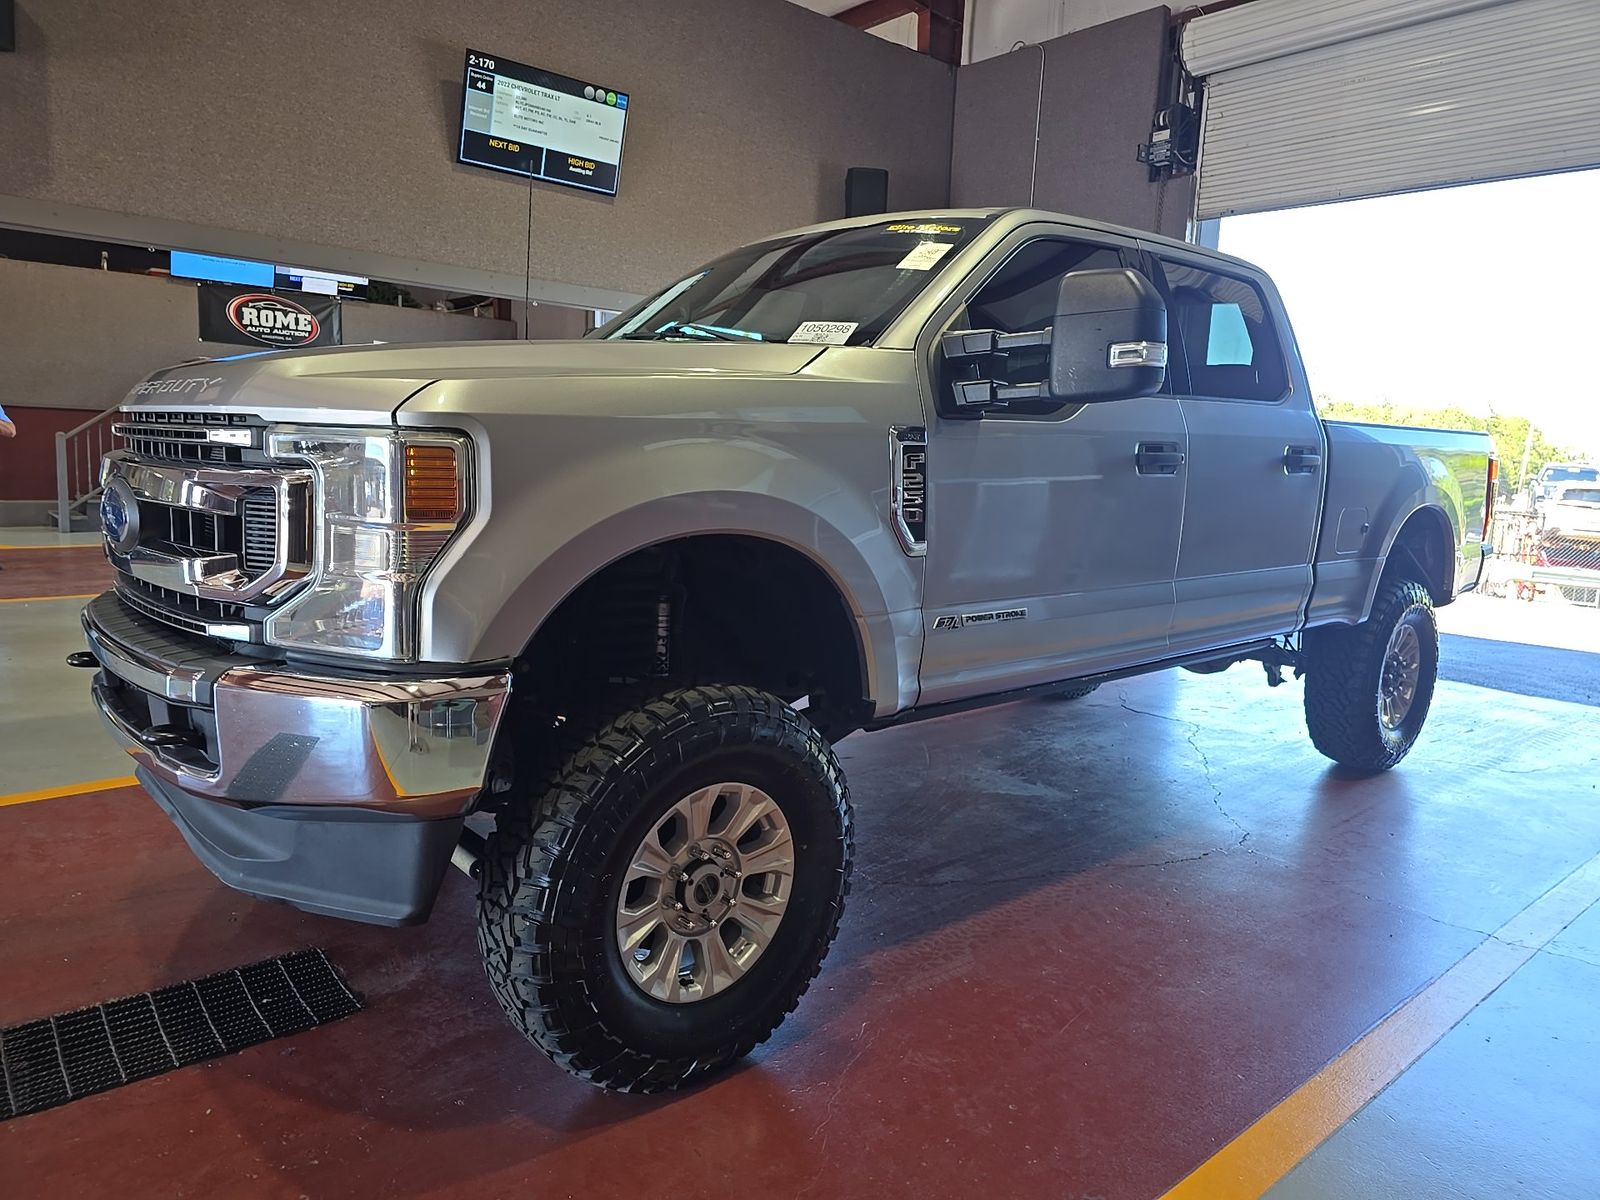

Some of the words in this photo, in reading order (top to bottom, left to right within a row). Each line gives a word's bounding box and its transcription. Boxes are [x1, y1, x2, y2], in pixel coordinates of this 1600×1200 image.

[468, 54, 495, 70] 2-170
[476, 80, 486, 90] 44
[497, 79, 511, 89] 2022
[511, 83, 541, 96] CHEVROLET
[541, 91, 554, 100] TRAX
[554, 94, 561, 102] LT
[488, 138, 508, 150] NEXT
[507, 143, 520, 152] BID
[568, 157, 584, 167] HIGH
[584, 161, 596, 170] BID
[241, 307, 312, 331] ROME
[272, 329, 309, 337] AUCTION
[801, 323, 851, 333] 1050298
[156, 377, 223, 394] DUTY
[965, 613, 994, 623] POWER
[995, 609, 1027, 620] STROKE
